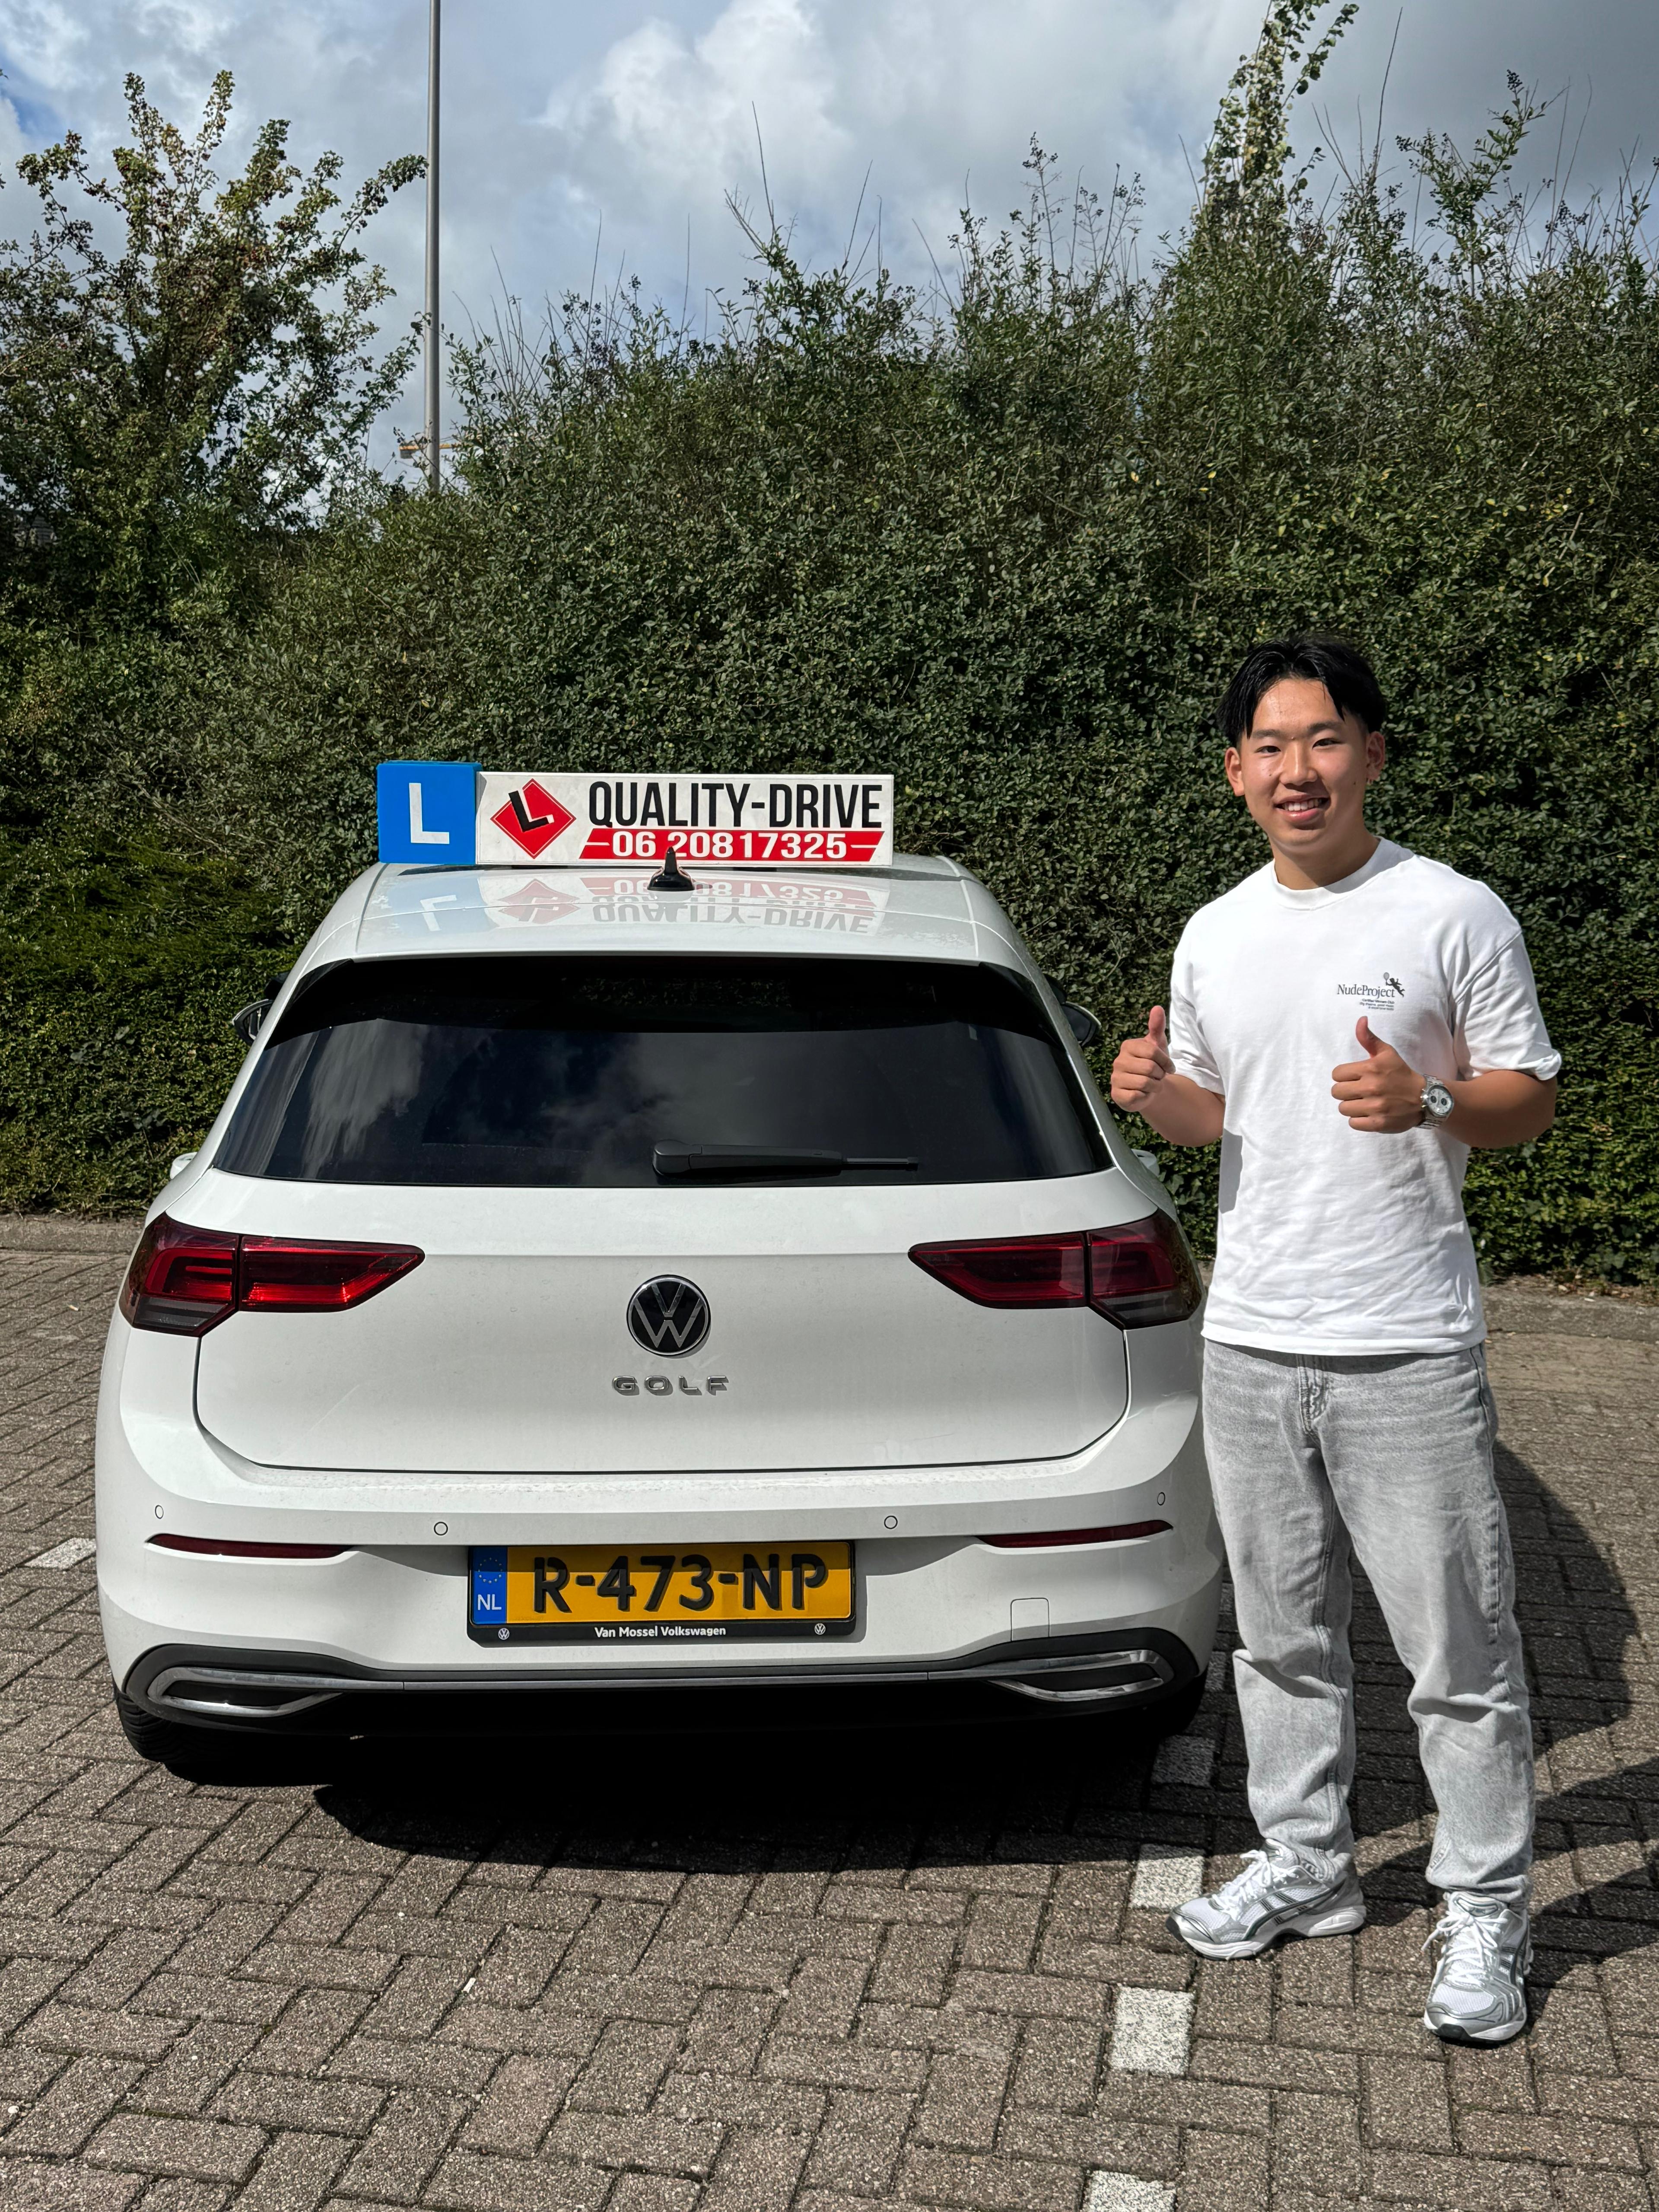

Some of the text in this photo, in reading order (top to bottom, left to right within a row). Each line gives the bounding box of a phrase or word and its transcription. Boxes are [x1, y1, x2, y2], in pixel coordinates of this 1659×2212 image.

[409, 782, 450, 844] L
[589, 781, 882, 828] QUALITY-DRIVE
[612, 831, 847, 859] 06 20817325
[1337, 984, 1395, 999] NudeProject
[612, 1375, 728, 1392] GOLF
[534, 1553, 829, 1613] R-473-NP
[477, 1594, 502, 1611] NL
[594, 1626, 726, 1637] Van Mossel Volkswagen
